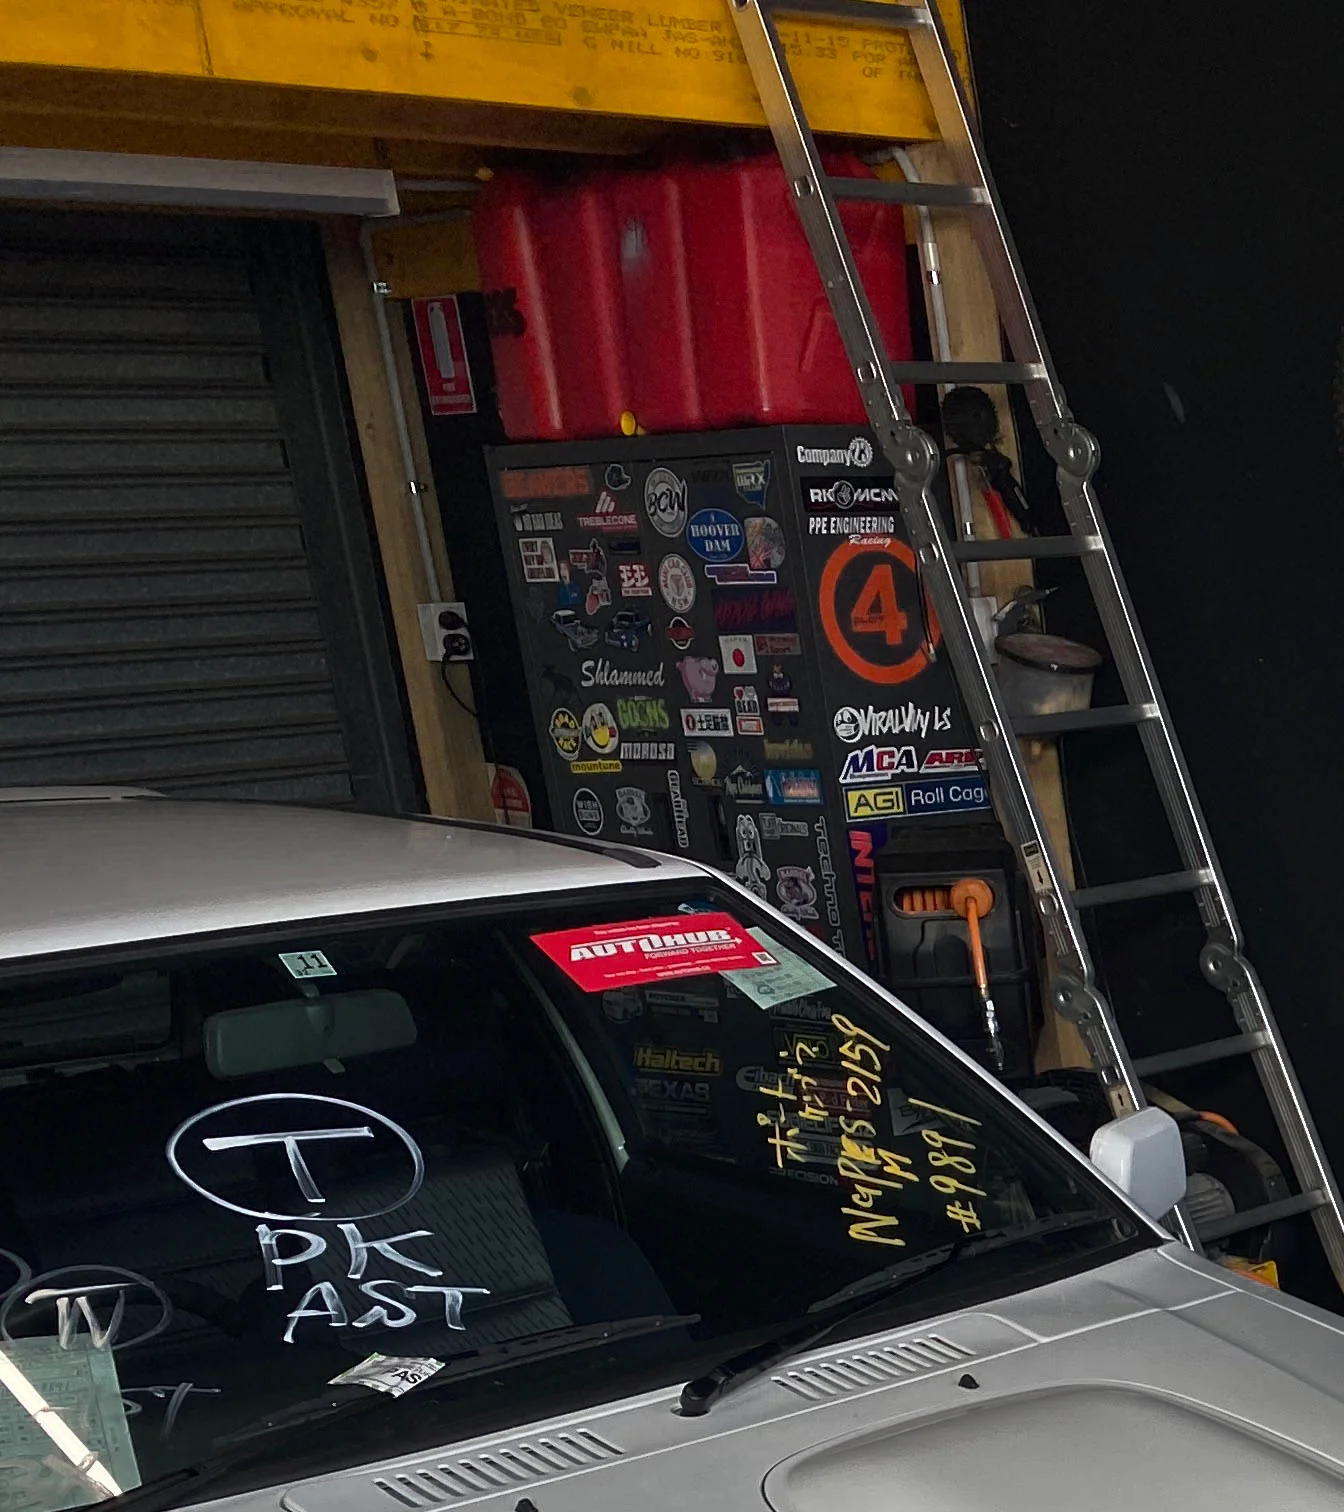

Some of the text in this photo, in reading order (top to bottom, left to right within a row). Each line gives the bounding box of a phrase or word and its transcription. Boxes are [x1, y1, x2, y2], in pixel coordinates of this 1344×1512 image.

[797, 445, 851, 467] Company
[691, 524, 740, 538] HOOVER
[809, 516, 895, 535] PPE ENGINEERING
[704, 539, 731, 552] DAM
[848, 534, 893, 548] Racing
[851, 563, 908, 642] 4
[581, 658, 665, 688] Shlammed
[620, 742, 675, 760] MOROSO
[572, 760, 621, 772] mountune
[843, 747, 916, 780] MCA
[853, 791, 901, 814] AGI
[911, 786, 945, 806] Roll
[570, 928, 732, 962] AUTOHUB
[644, 943, 737, 961] FORWARD TOGETHER
[297, 953, 329, 972] 11
[636, 1046, 721, 1074] Haltech
[256, 1222, 444, 1291] PK
